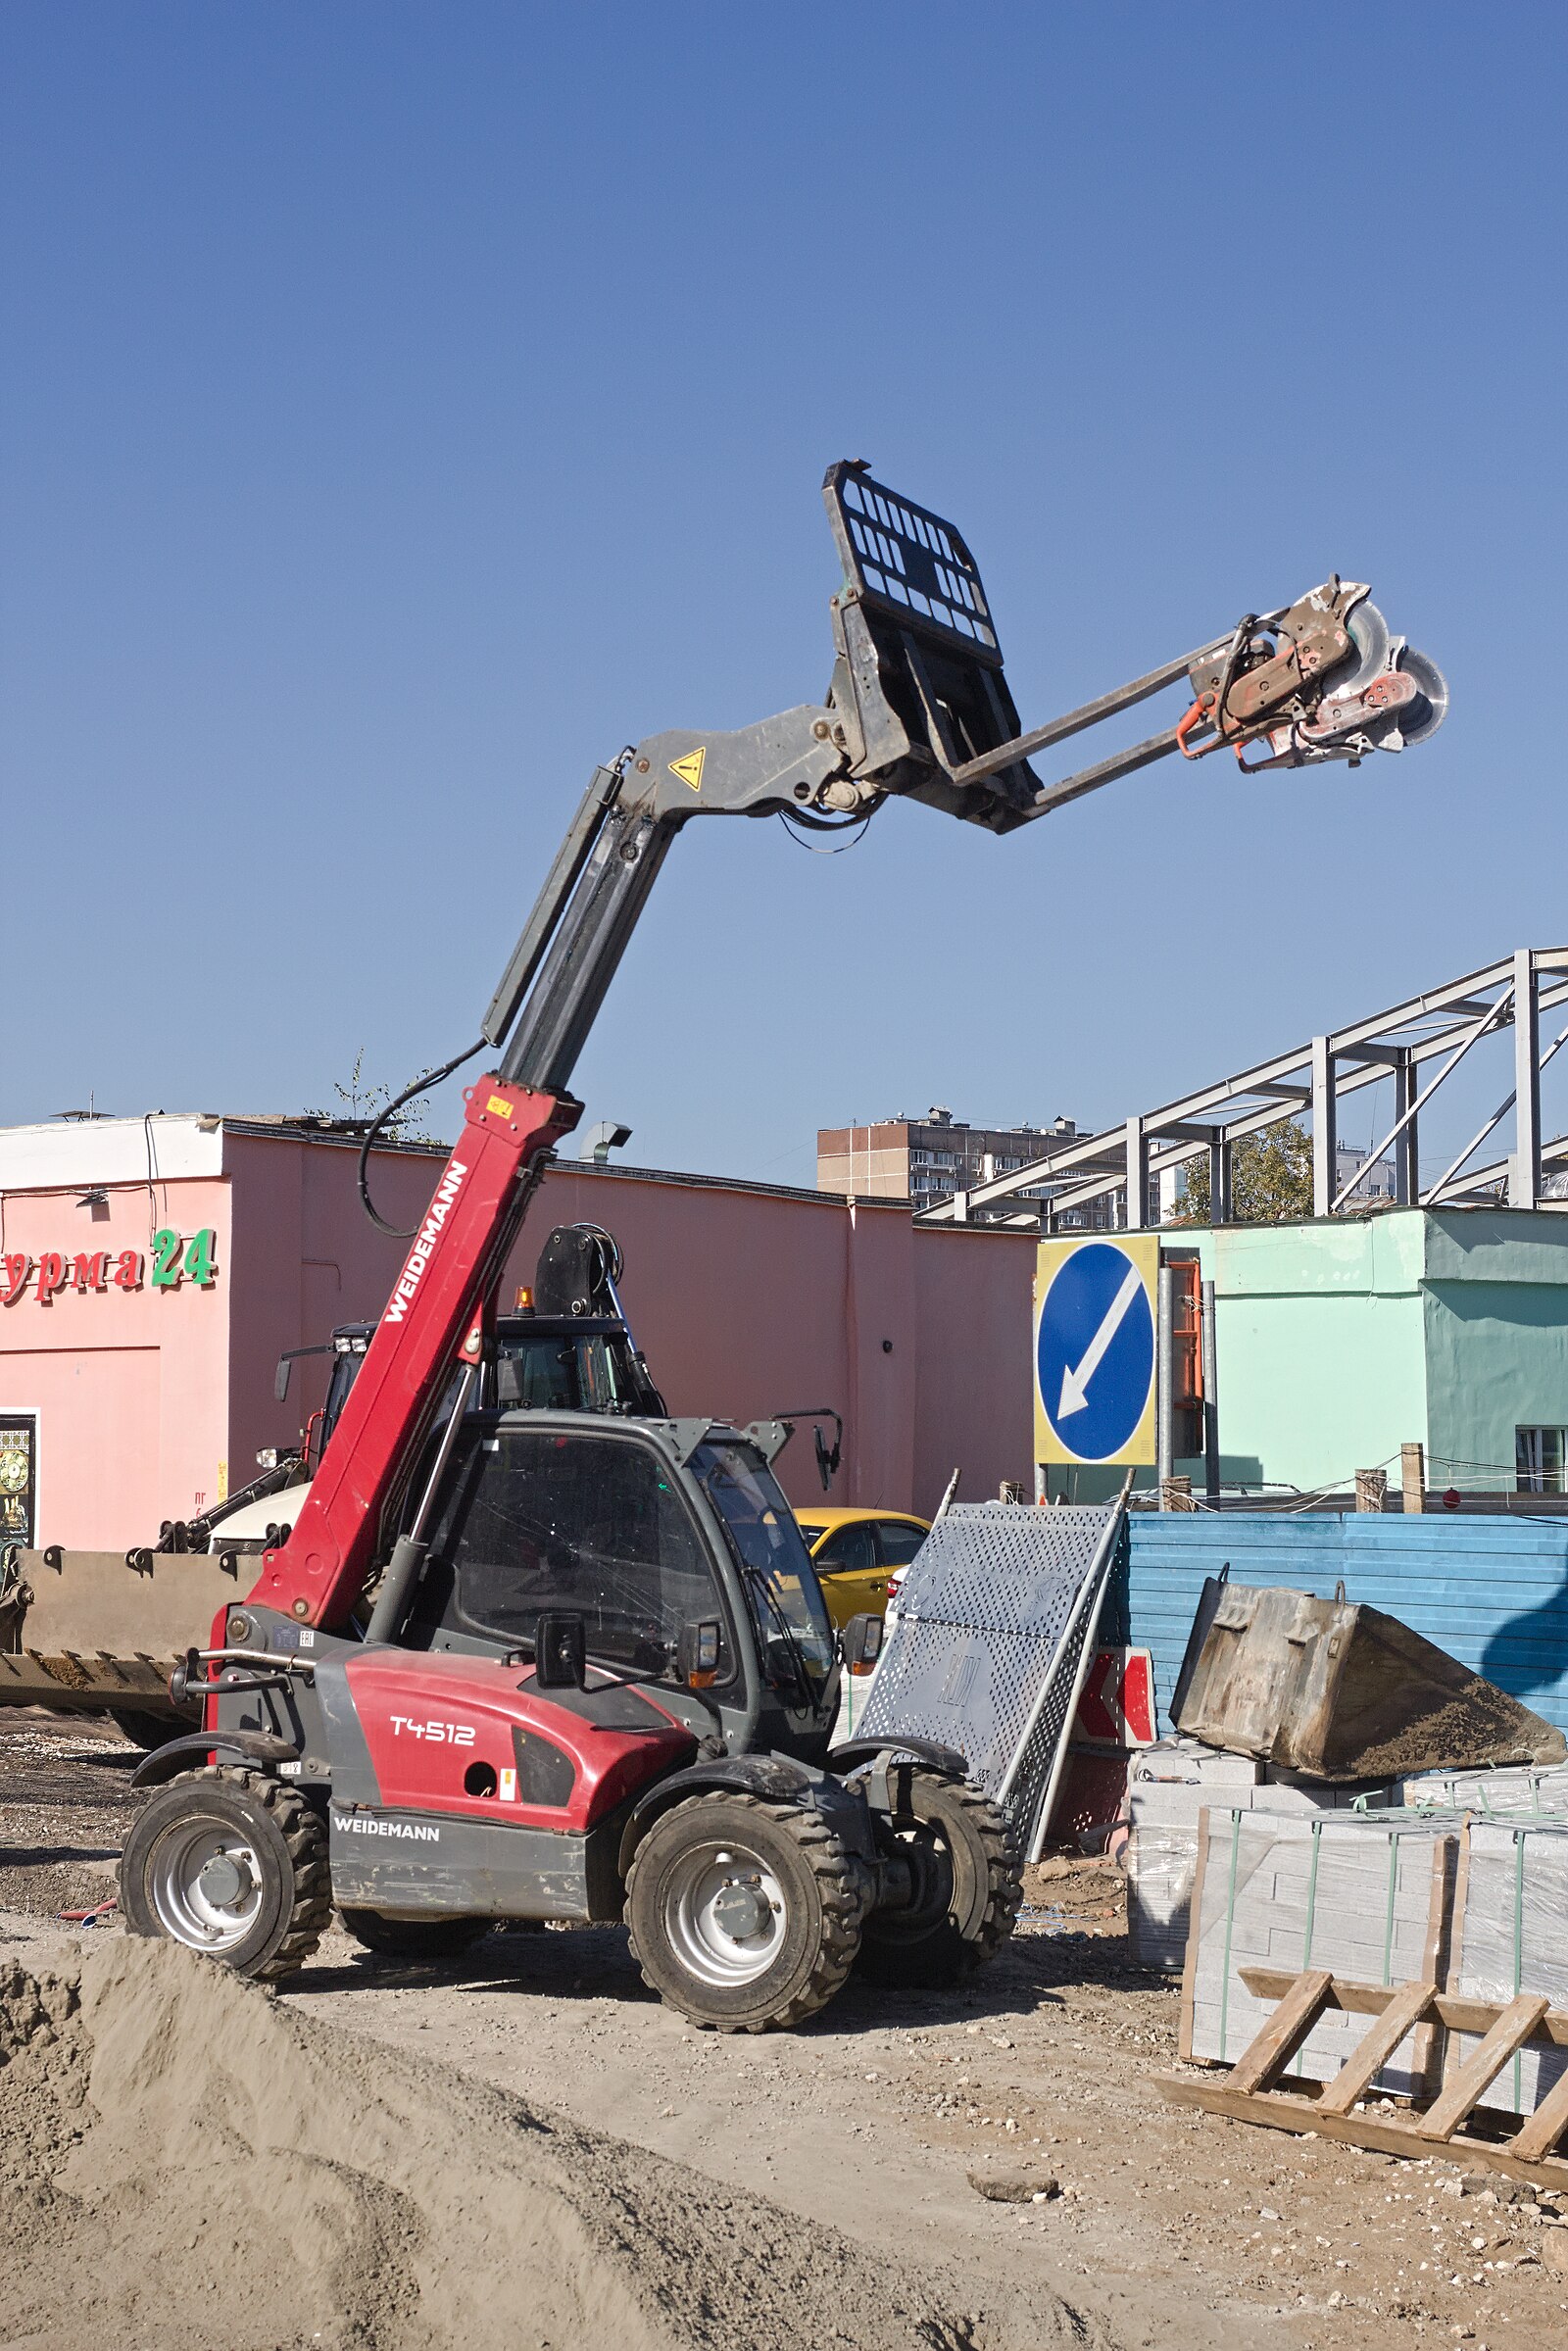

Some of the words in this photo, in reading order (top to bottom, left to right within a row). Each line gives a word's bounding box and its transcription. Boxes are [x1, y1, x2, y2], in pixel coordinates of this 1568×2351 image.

[152, 1228, 216, 1287] 24
[384, 1160, 468, 1322] WEIDEMANN
[390, 1716, 476, 1746] T4512
[333, 1817, 440, 1842] WEIDEMANN
